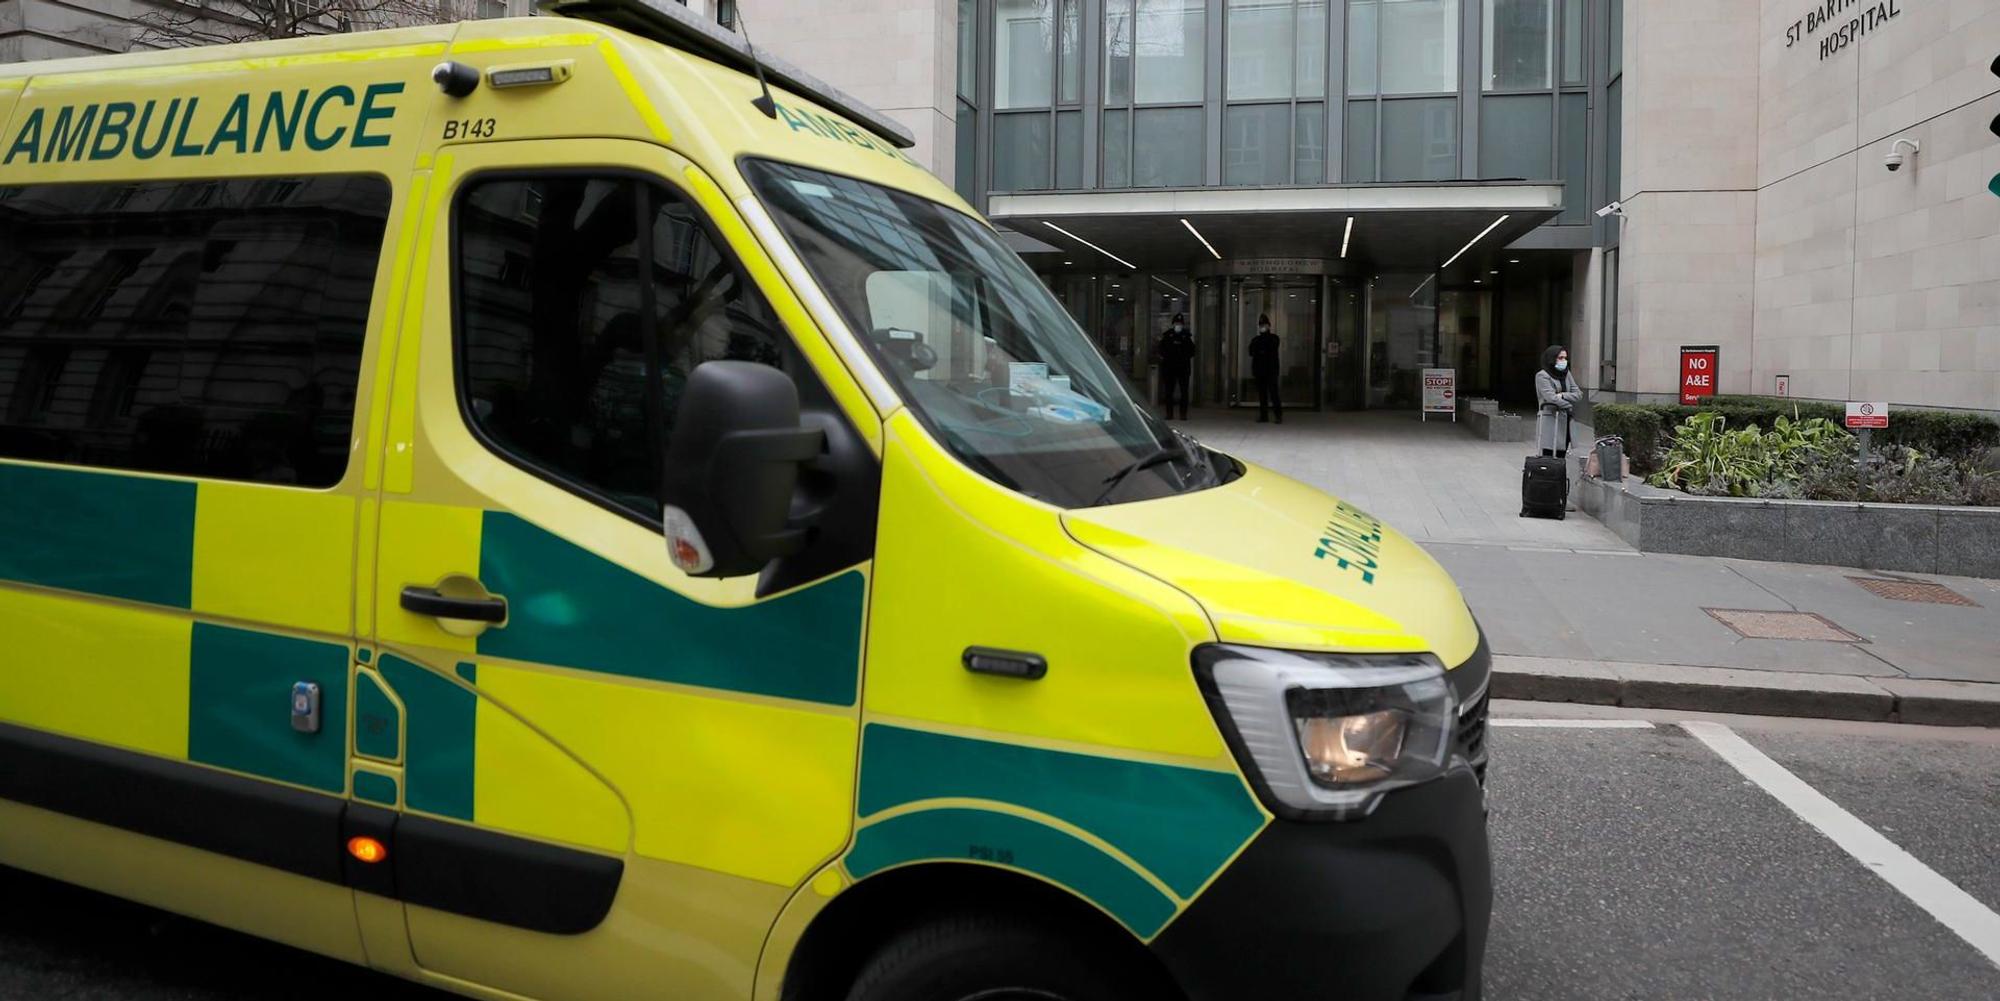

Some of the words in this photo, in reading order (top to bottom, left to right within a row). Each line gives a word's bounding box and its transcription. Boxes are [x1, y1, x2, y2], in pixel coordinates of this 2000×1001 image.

[1786, 20, 1802, 48] ST
[1819, 0, 1900, 61] HOSPITAL
[3, 82, 405, 165] AMBULANCE
[443, 118, 496, 140] B143
[1689, 358, 1707, 370] NO
[1426, 378, 1452, 386] STOP!
[1685, 375, 1710, 386] A&E
